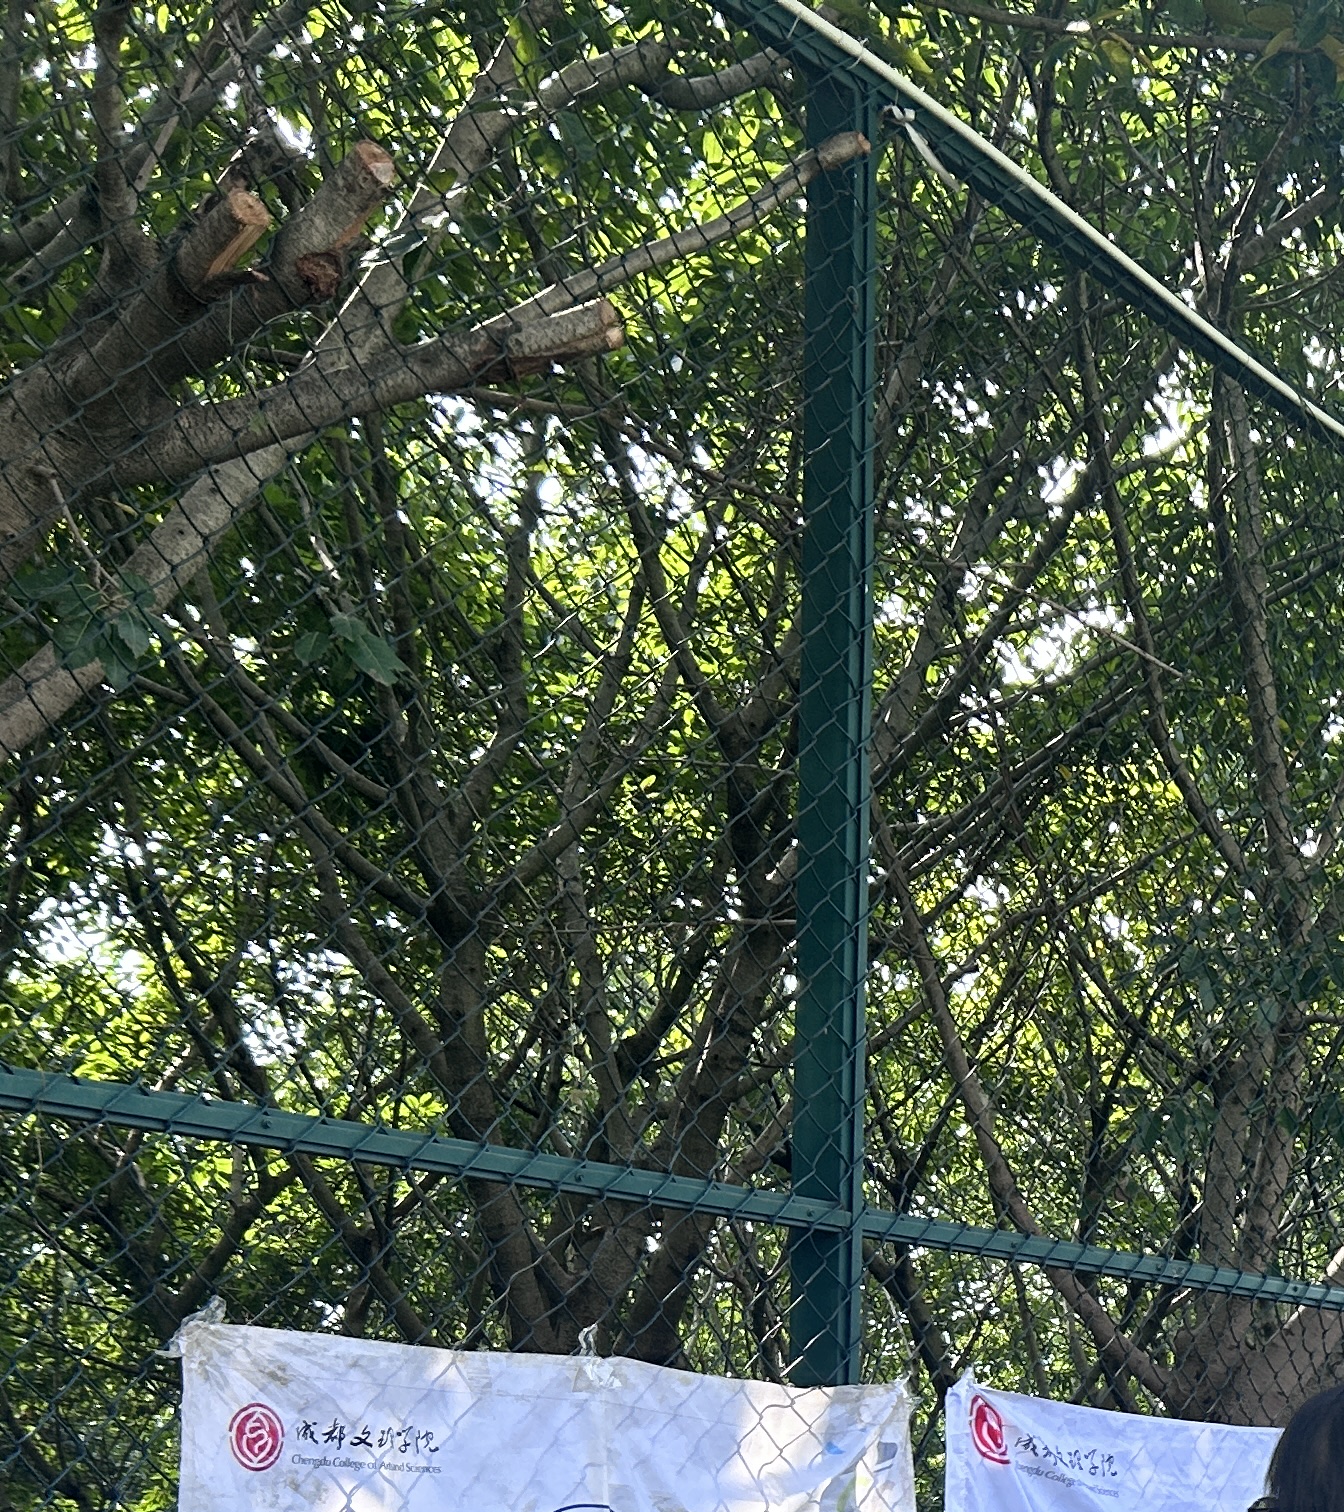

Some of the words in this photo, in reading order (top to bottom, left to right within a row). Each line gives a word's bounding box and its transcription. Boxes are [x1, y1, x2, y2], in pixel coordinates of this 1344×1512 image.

[296, 1417, 439, 1454] 成都文理学院
[291, 1454, 332, 1469] Chengdu
[332, 1456, 366, 1471] College
